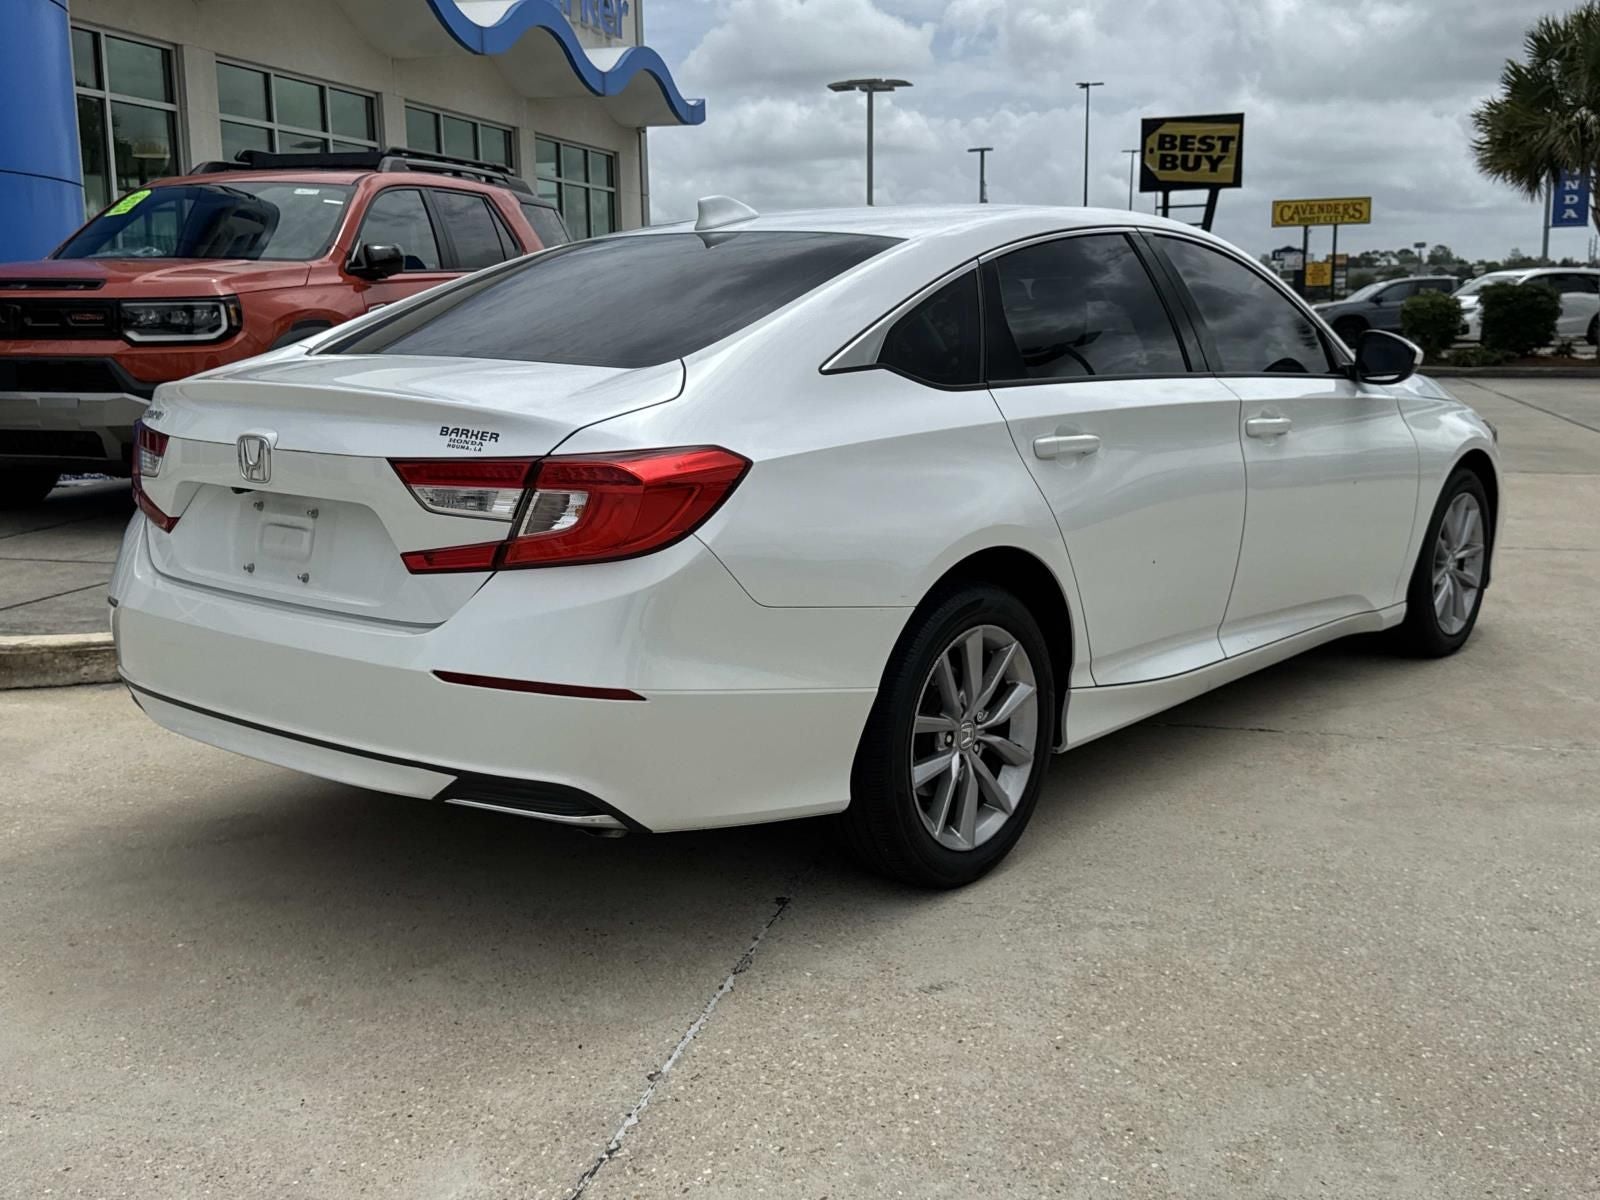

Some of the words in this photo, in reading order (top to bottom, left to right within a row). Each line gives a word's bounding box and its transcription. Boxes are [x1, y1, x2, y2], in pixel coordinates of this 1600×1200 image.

[1157, 133, 1236, 153] BEST
[1158, 153, 1227, 173] BUY
[1279, 202, 1364, 223] CAVENDER'S
[439, 426, 500, 443] BARKER
[448, 437, 484, 447] HONDA
